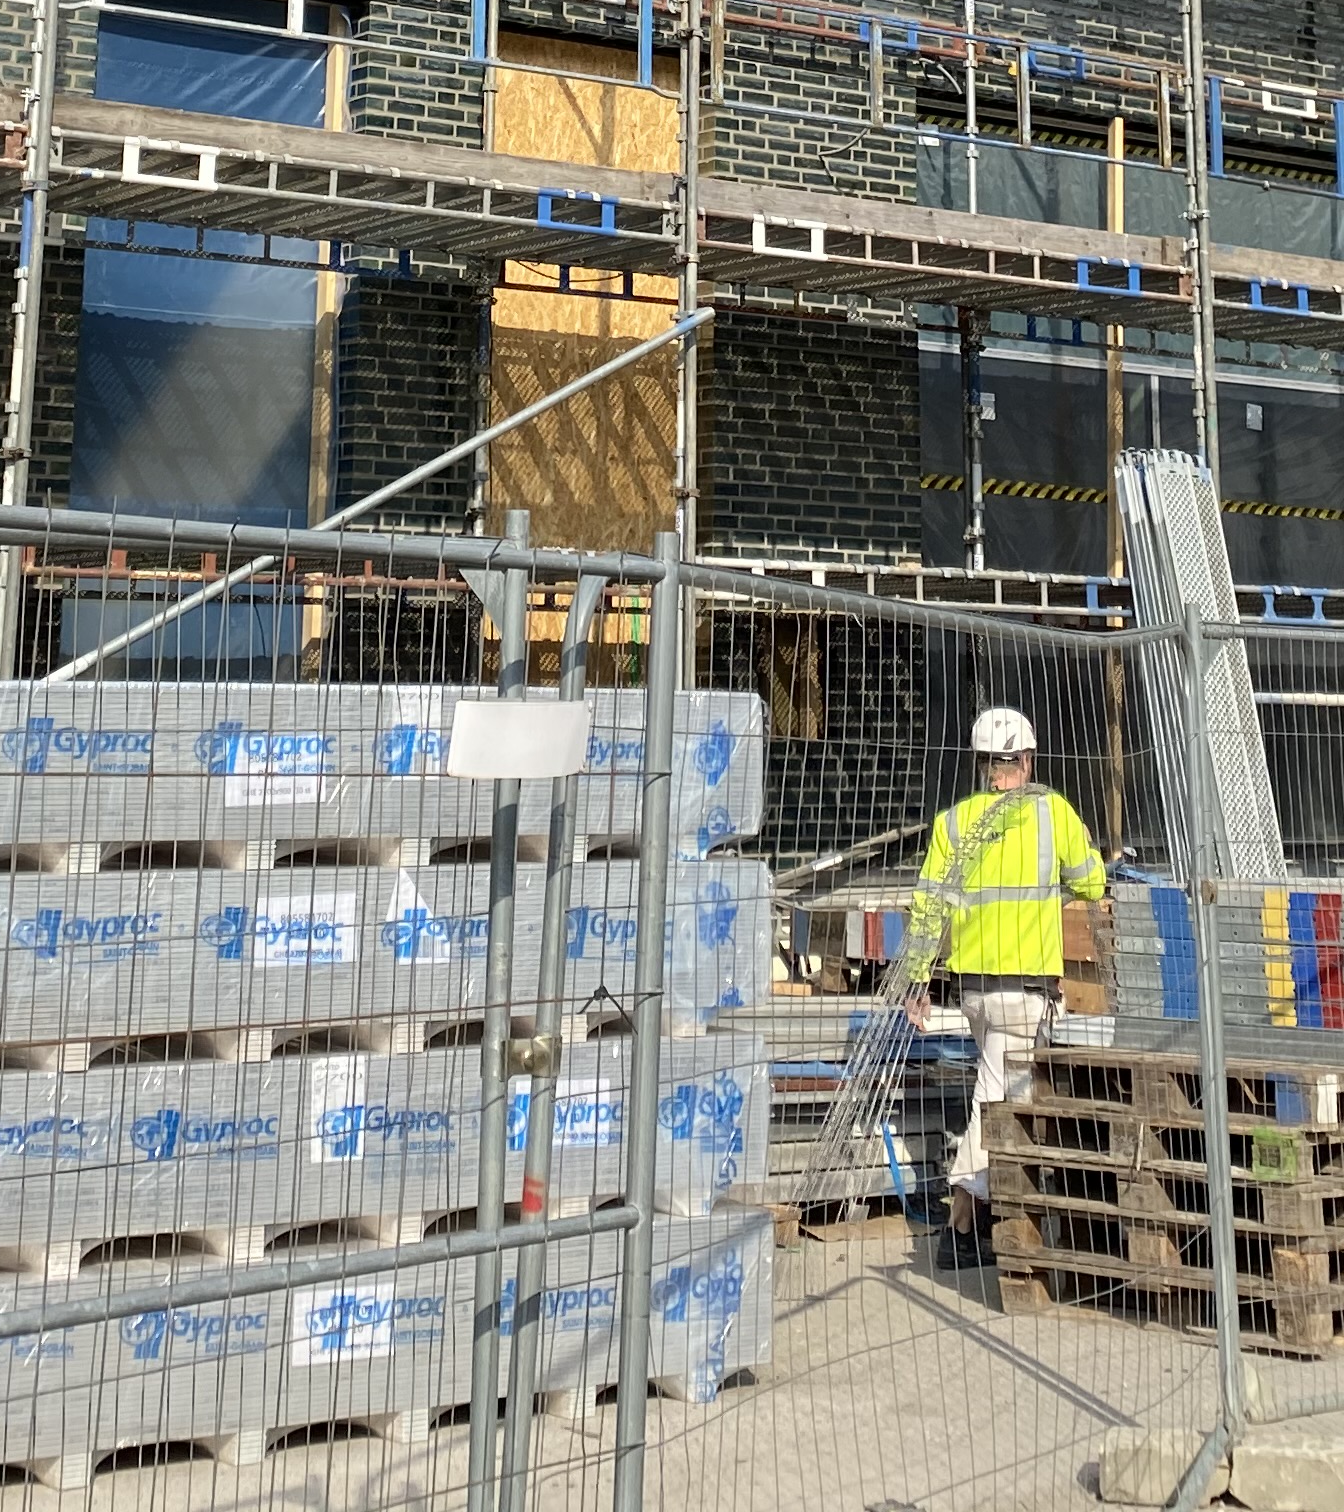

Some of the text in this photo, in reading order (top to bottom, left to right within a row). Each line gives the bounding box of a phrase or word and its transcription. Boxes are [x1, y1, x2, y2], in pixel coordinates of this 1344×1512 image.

[53, 727, 153, 759] Gyproc
[242, 732, 338, 761] Gyproc
[365, 1105, 454, 1141] Gyproc
[554, 1100, 623, 1132] yproc
[354, 1296, 445, 1326] Gyproc
[542, 1287, 616, 1320] yproc
